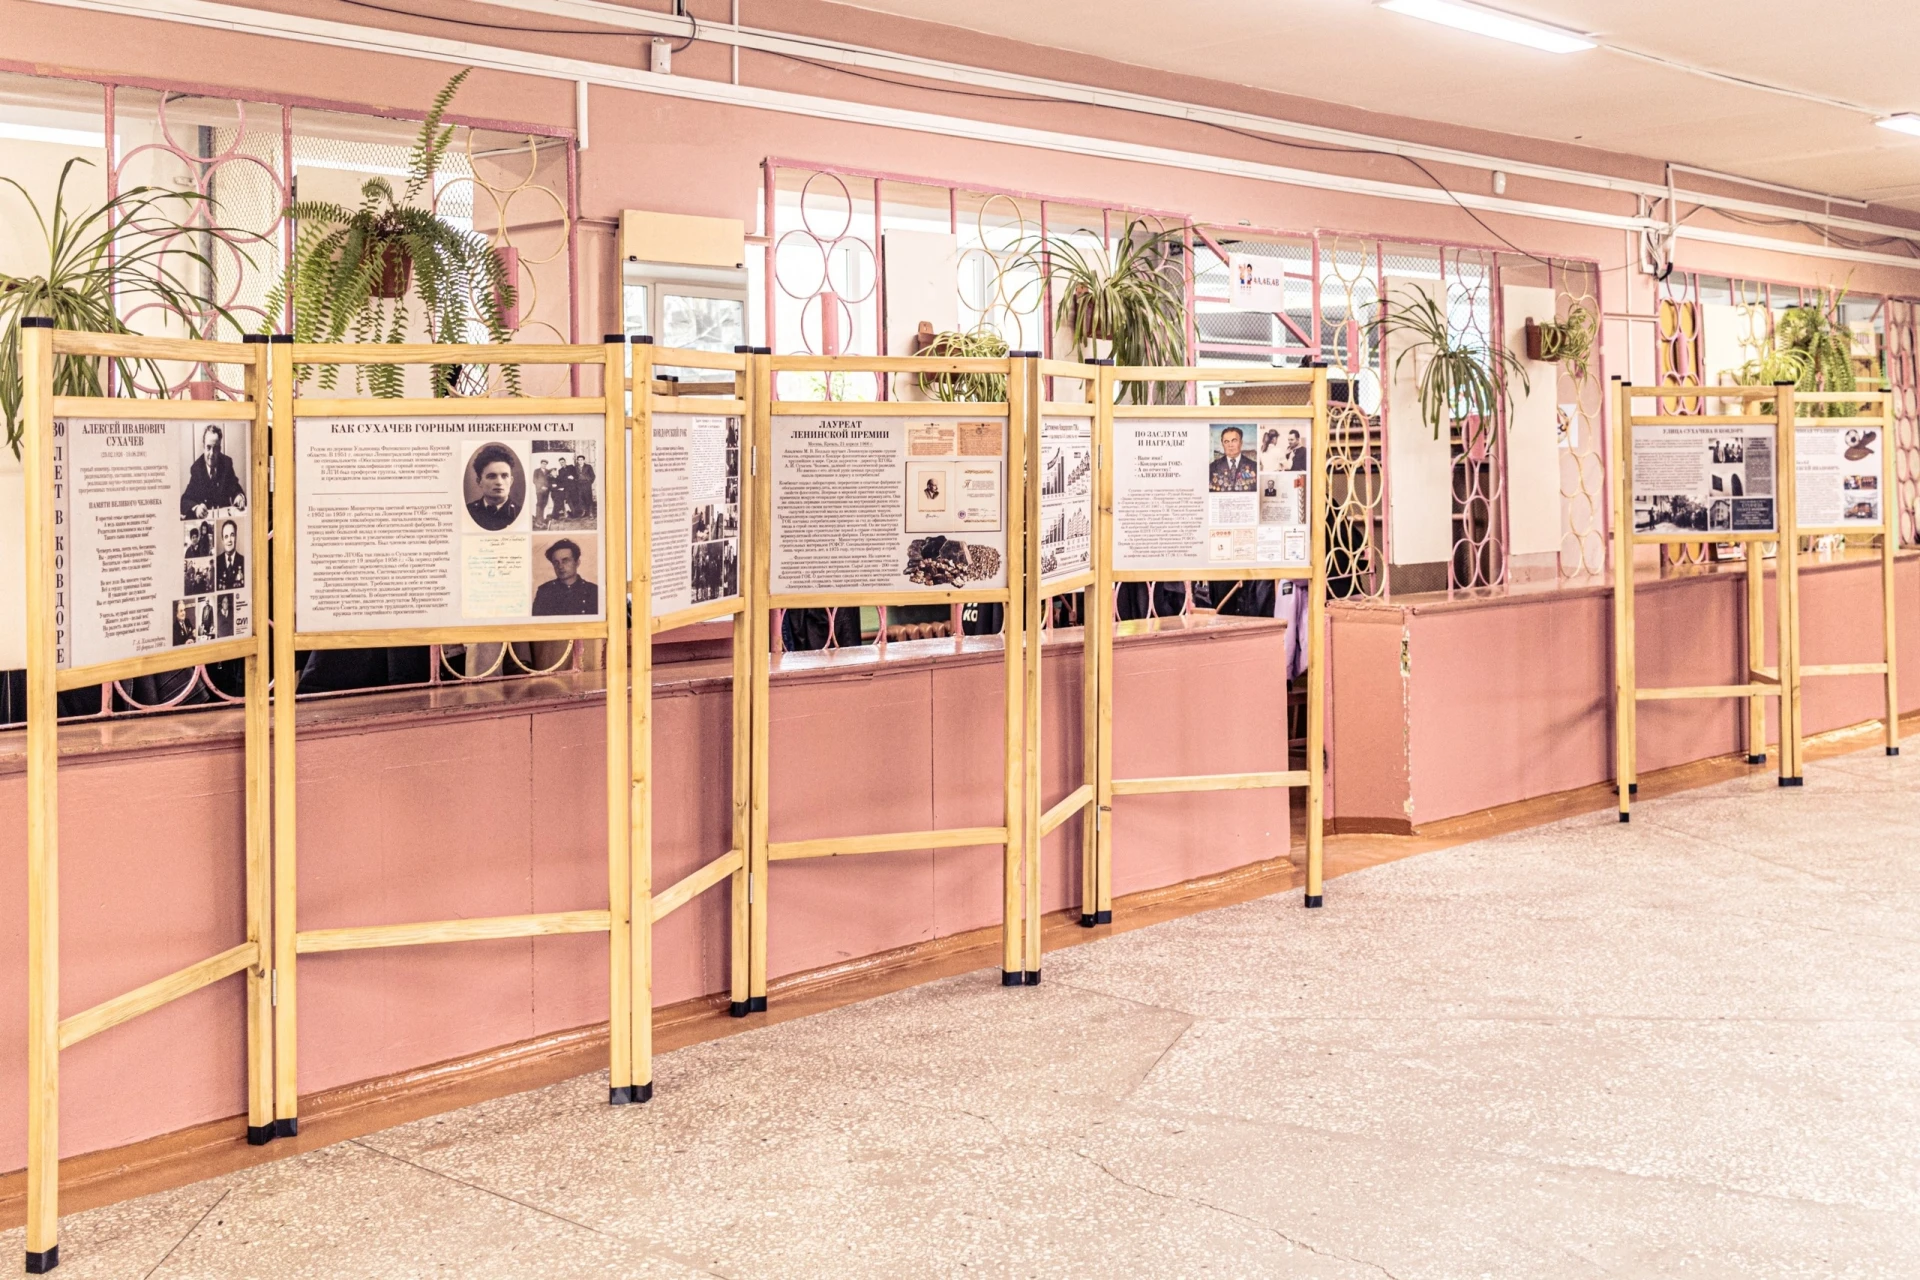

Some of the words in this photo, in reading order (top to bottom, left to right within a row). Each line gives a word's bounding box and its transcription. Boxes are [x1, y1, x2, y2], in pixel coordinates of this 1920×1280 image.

[82, 421, 120, 434] АЛЕКСЕЙ
[122, 423, 165, 434] ИВАНОВИЧ
[331, 424, 354, 433] КАК
[358, 424, 412, 433] СУХАЧЕВ
[416, 423, 465, 432] ГОРНЫМ
[468, 423, 541, 432] ИНЖЕНЕРОМ
[544, 423, 574, 432] СТАЛ
[653, 426, 679, 437] КОВДОРСКИЙ
[791, 429, 848, 438] ЛЕНИНСКОЙ
[106, 436, 144, 446] СУХАЧЕВ
[54, 446, 62, 499] ЛЕТ
[55, 510, 63, 524] В
[55, 536, 64, 664] КОВДОРЕ
